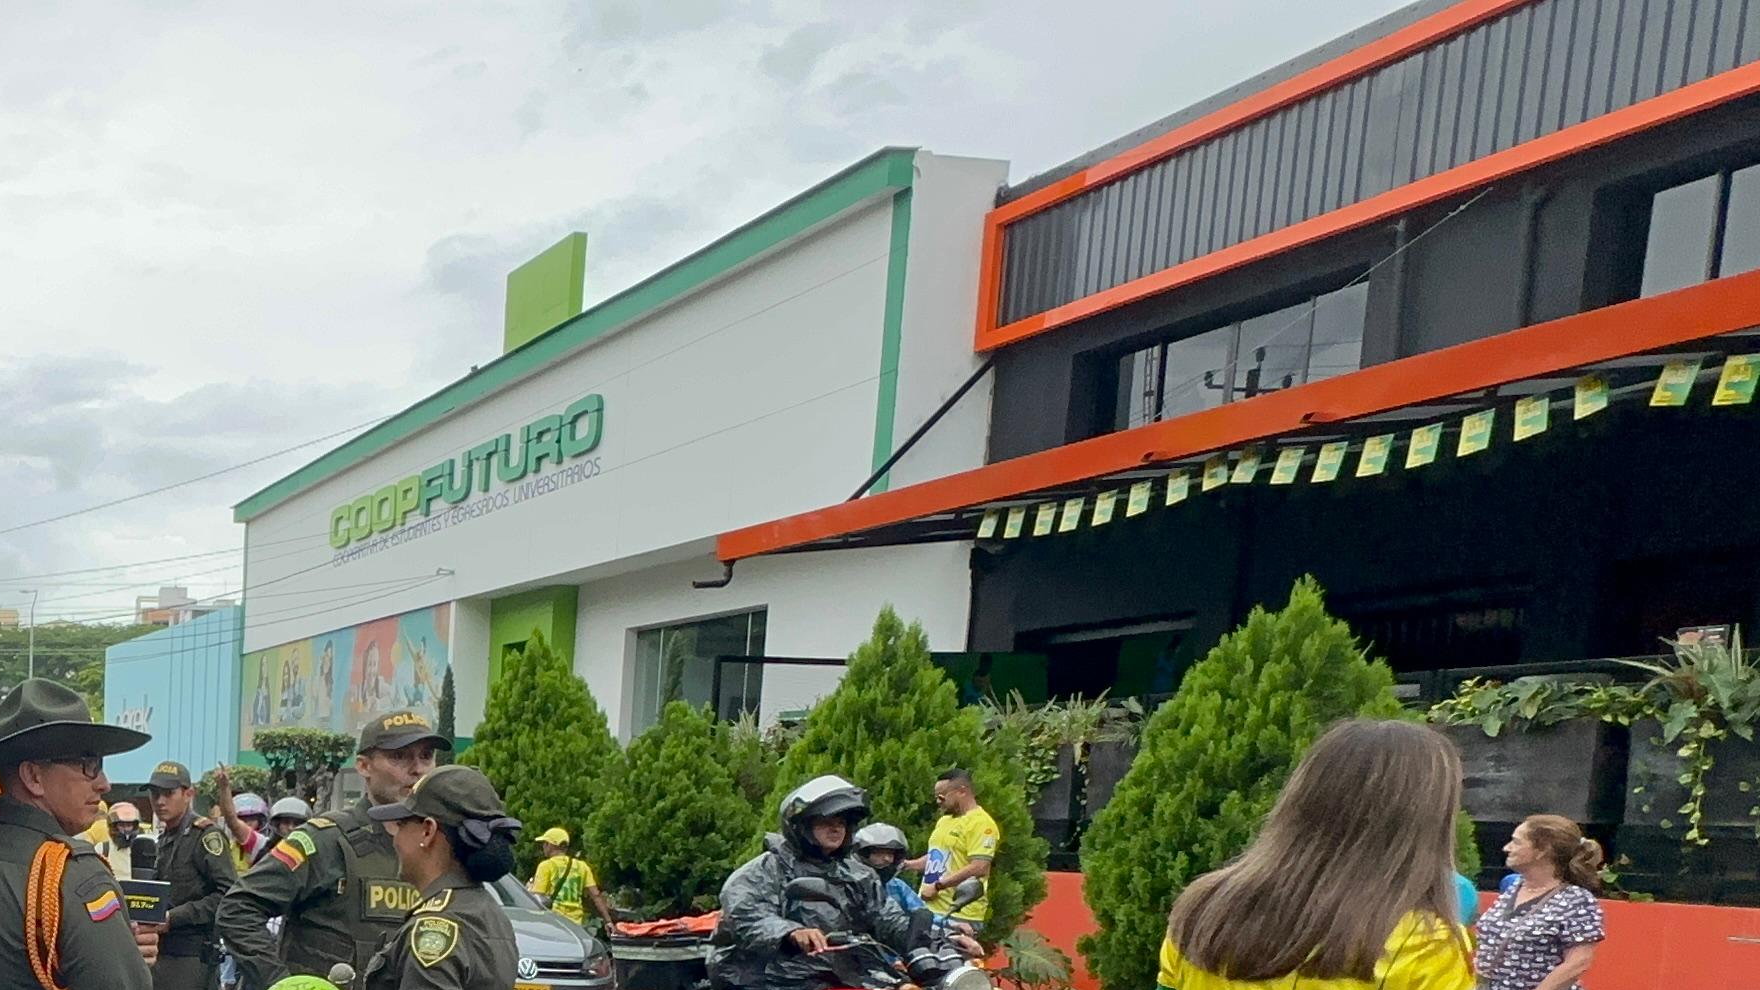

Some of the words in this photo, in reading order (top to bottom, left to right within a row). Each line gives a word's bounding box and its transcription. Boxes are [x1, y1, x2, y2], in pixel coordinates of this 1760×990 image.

[329, 393, 604, 550] COOPFUTURO
[450, 489, 510, 527] EGRESADOS
[513, 457, 602, 505] UNIVERSITARIOS
